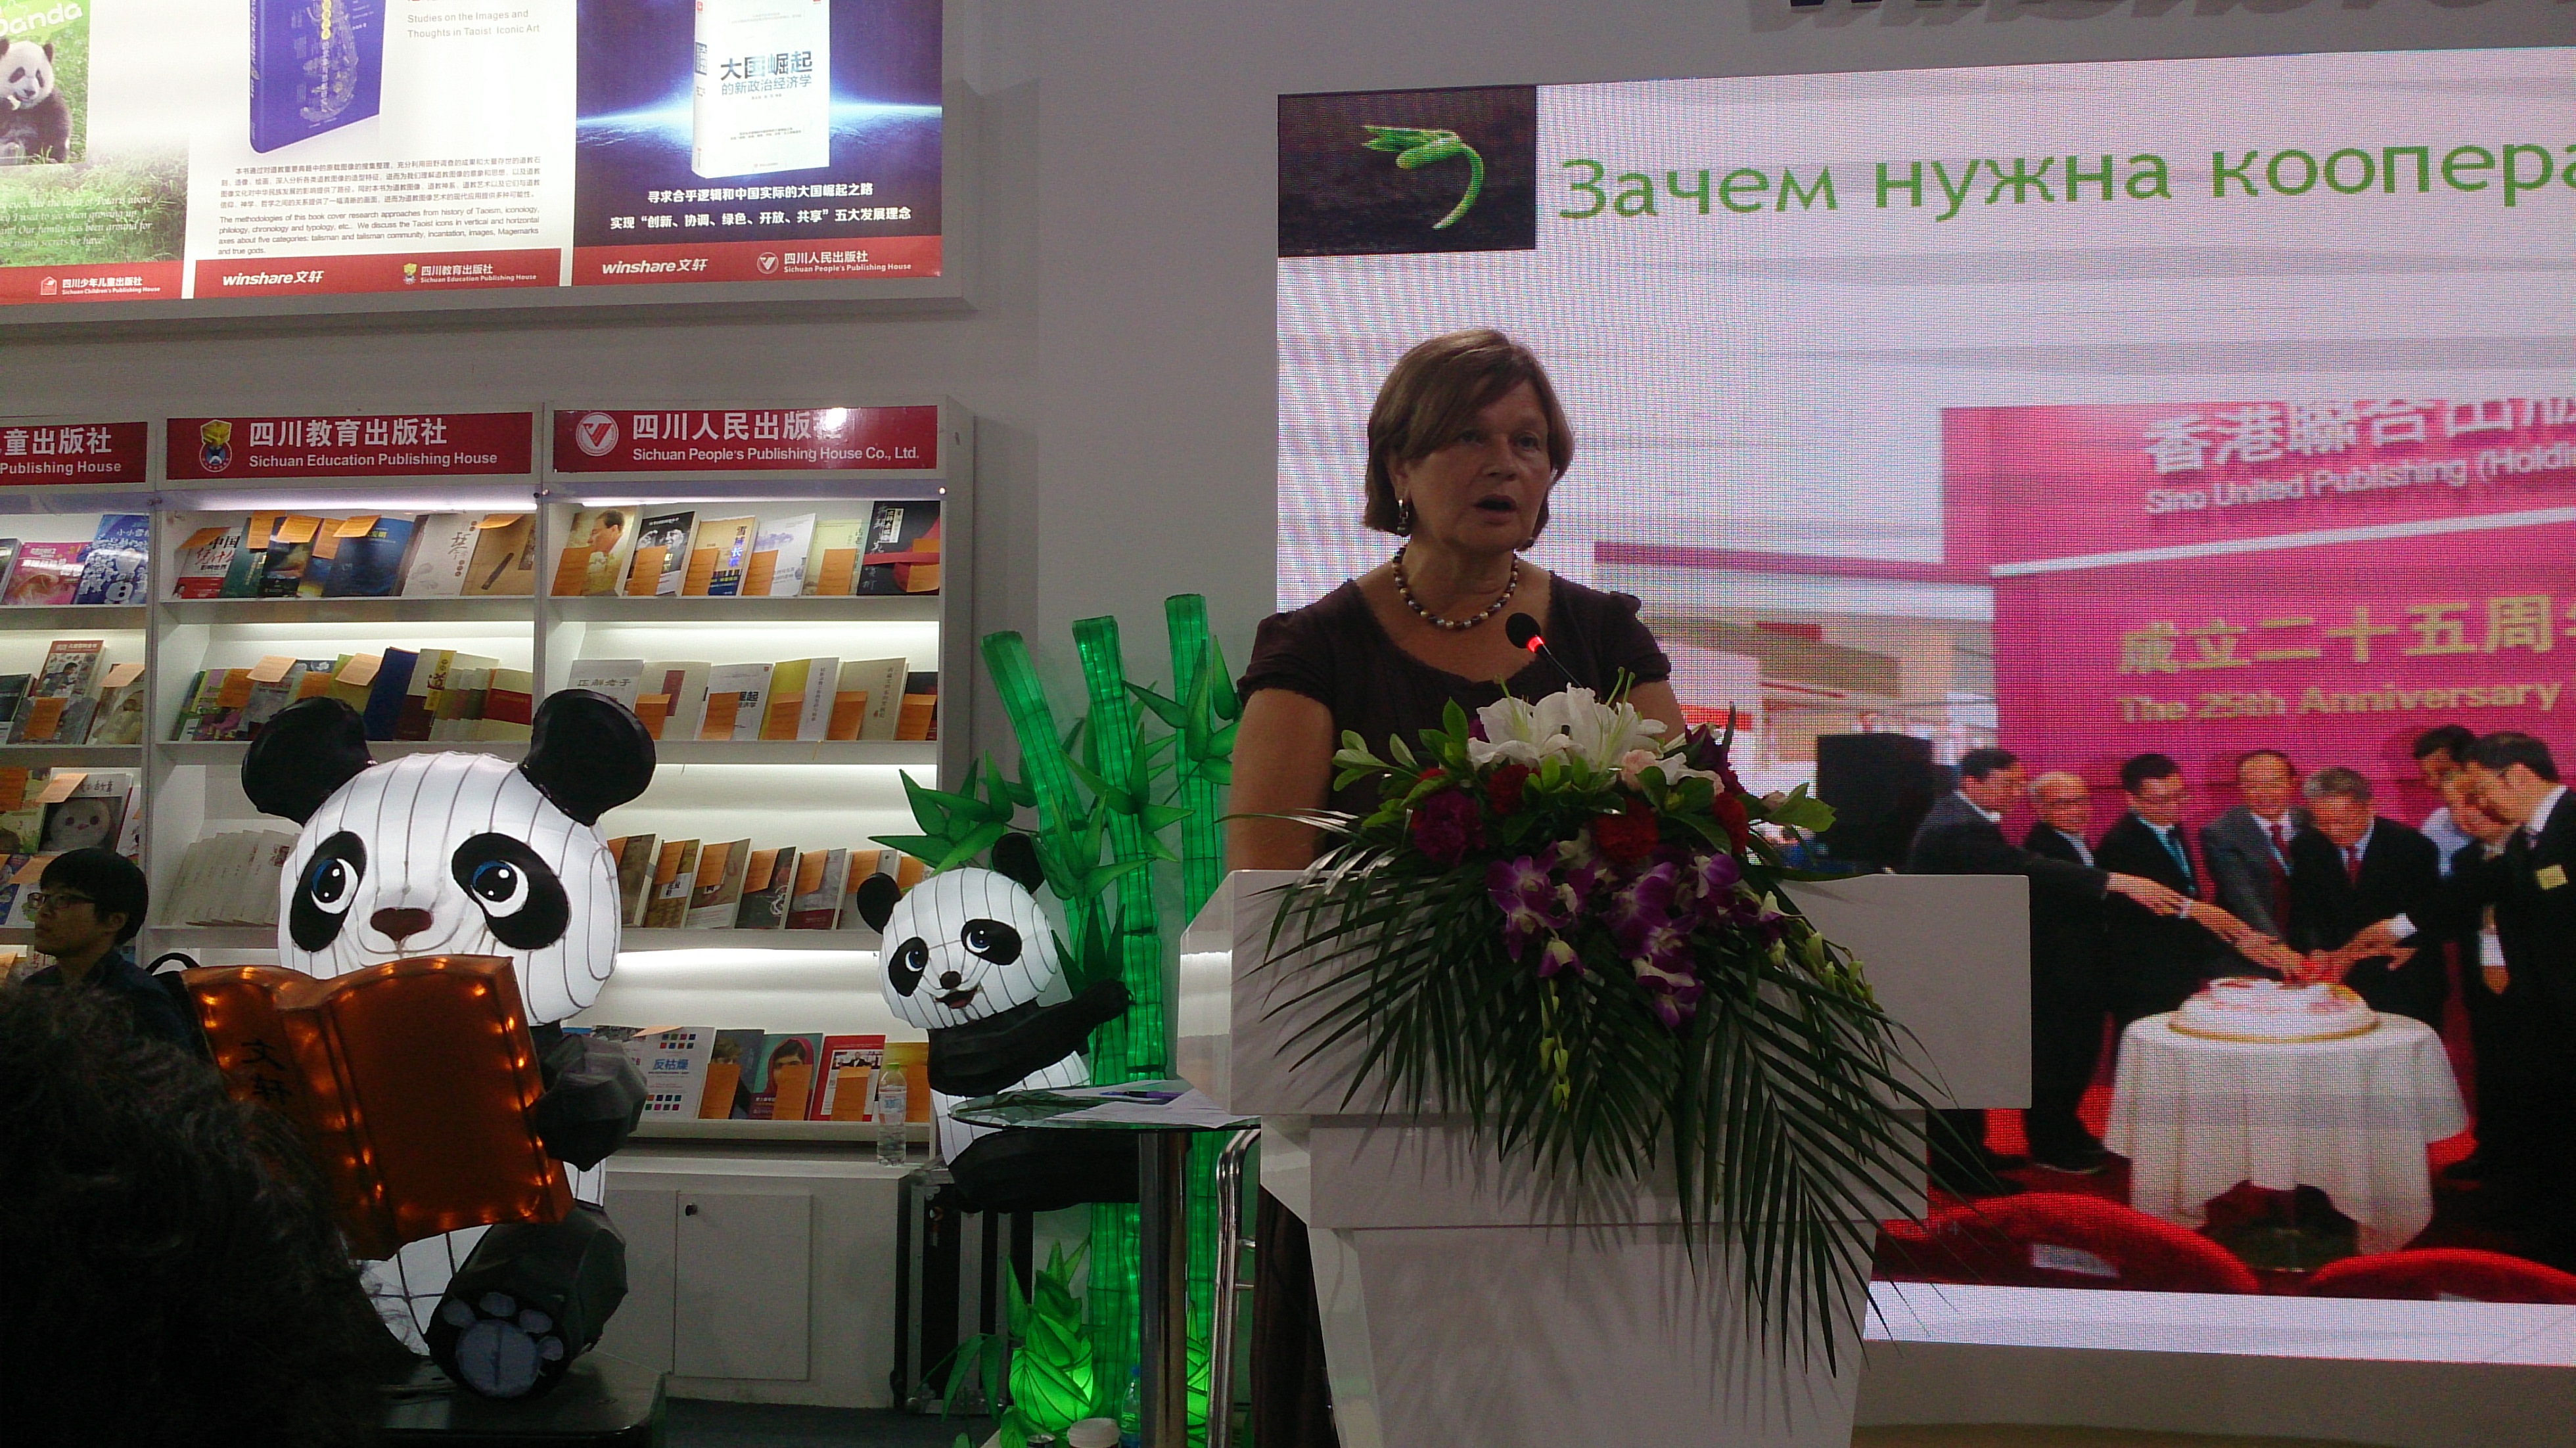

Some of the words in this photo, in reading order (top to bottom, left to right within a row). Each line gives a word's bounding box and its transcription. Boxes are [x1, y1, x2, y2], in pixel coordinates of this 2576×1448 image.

[407, 14, 442, 23] Studies
[459, 12, 473, 21] the
[476, 11, 509, 21] Images
[511, 9, 528, 18] and
[407, 29, 450, 39] Thoughts
[464, 27, 492, 36] Taoist
[497, 25, 524, 34] Iconic
[720, 51, 813, 81] 大国崛起
[722, 74, 812, 96] 的新政治经济学
[648, 183, 873, 203] 寻求合乎逻辑和中国实际的大国崛起之路
[1559, 158, 1836, 219] Зачем
[1877, 153, 2171, 222] нужна
[235, 214, 283, 224] methodologies
[381, 210, 421, 218] approaches
[442, 208, 463, 217] history
[252, 225, 288, 234] chronology
[272, 235, 309, 244] categories:
[497, 227, 539, 236] Magemarks
[248, 247, 265, 256] gods.
[784, 250, 868, 264] 四川人民出版社
[421, 263, 494, 276] 四川教育出版社
[815, 265, 845, 273] People's
[846, 263, 886, 272] Publishing
[62, 277, 142, 288] 四川少年儿童出版社
[250, 418, 448, 448] 四川教育出版社
[0, 426, 112, 457] 童出版社
[249, 455, 304, 467] Sichuan
[307, 453, 375, 466] Education
[378, 452, 450, 468] Publishing
[453, 452, 497, 464] House
[633, 447, 685, 461] Sichuan
[689, 447, 744, 463] People's
[747, 447, 816, 463] Publishing
[819, 447, 862, 459] House
[865, 447, 890, 461] Co.,
[895, 447, 919, 459] Ltd.
[1, 461, 74, 476] Publishing
[78, 461, 122, 472] House
[2213, 475, 2303, 506] United
[2312, 458, 2467, 495] Publishing
[2117, 595, 2576, 675] 成立二十五周
[2117, 697, 2188, 722] The
[2198, 689, 2286, 718] 25th
[2299, 682, 2561, 714] Anniversary
[653, 1058, 689, 1070] 反枯燥
